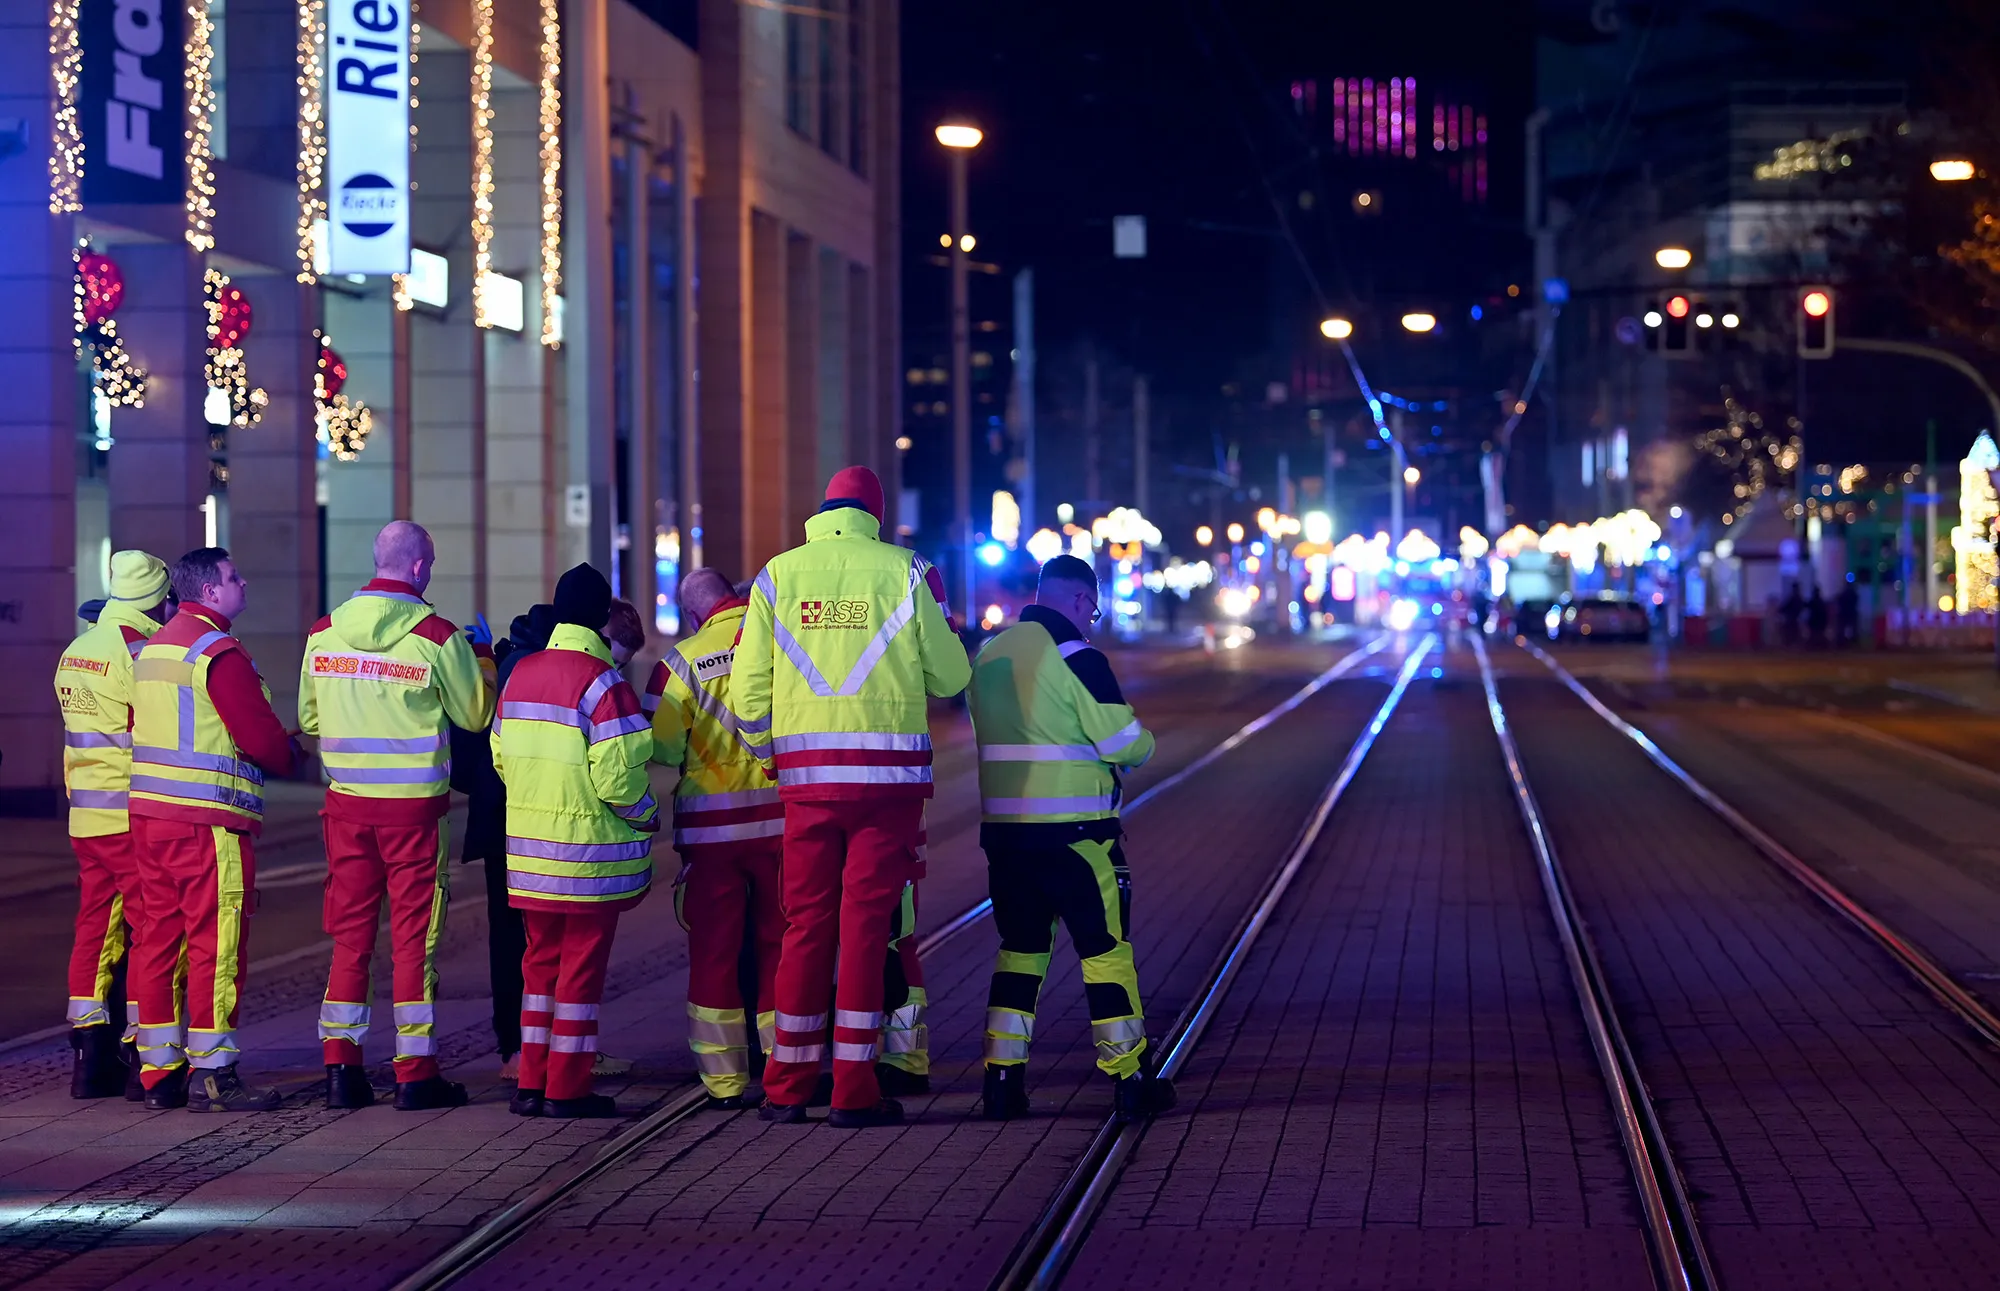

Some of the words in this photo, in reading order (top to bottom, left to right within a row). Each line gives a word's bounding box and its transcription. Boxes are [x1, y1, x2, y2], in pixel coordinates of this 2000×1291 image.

[337, 0, 398, 100] Rie
[815, 600, 869, 624] ASB
[326, 656, 359, 674] ASB
[360, 660, 427, 681] RETTUNGSDIENST
[69, 687, 98, 710] ASB
